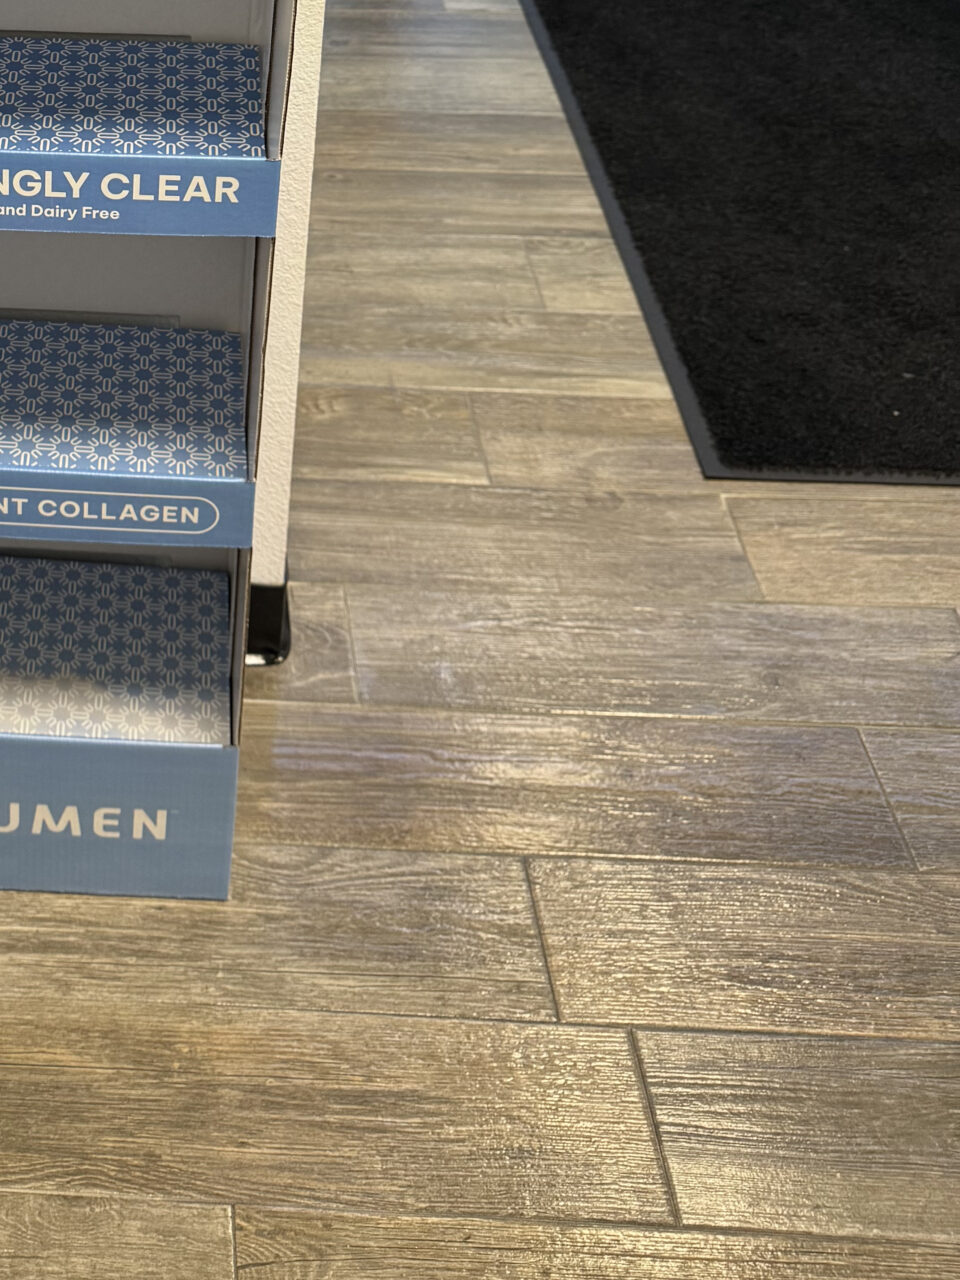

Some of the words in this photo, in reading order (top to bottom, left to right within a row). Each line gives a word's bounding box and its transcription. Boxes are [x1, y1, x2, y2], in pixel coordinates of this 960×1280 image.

[101, 171, 240, 203] CLEAR
[30, 203, 79, 221] Dairy
[82, 206, 120, 221] Free
[37, 498, 200, 525] COLLAGEN
